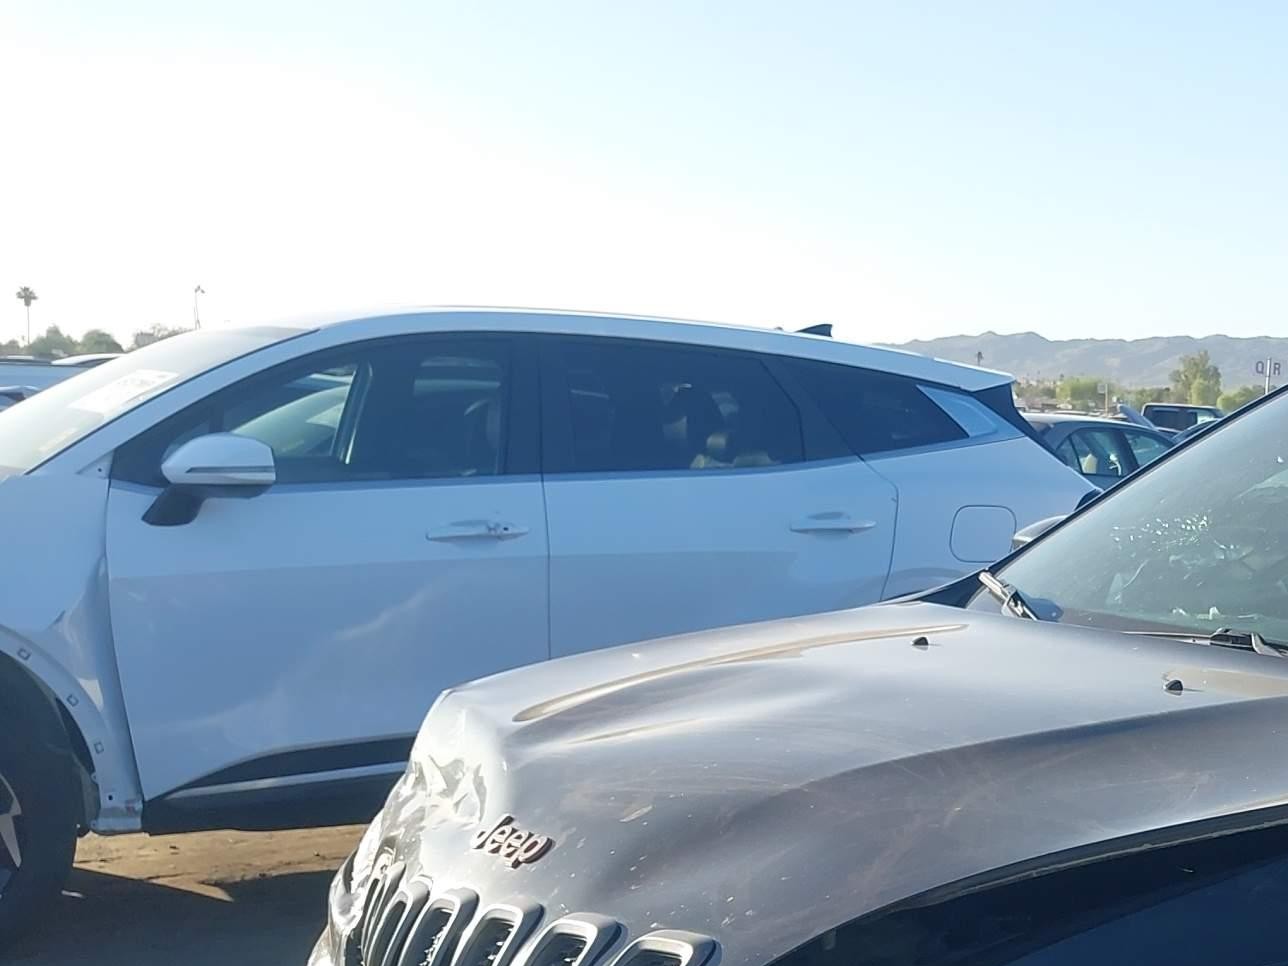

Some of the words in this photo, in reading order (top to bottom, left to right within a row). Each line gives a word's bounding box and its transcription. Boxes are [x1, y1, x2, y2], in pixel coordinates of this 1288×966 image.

[1256, 360, 1265, 375] Q
[1273, 362, 1281, 375] R
[472, 814, 556, 870] Jeep
